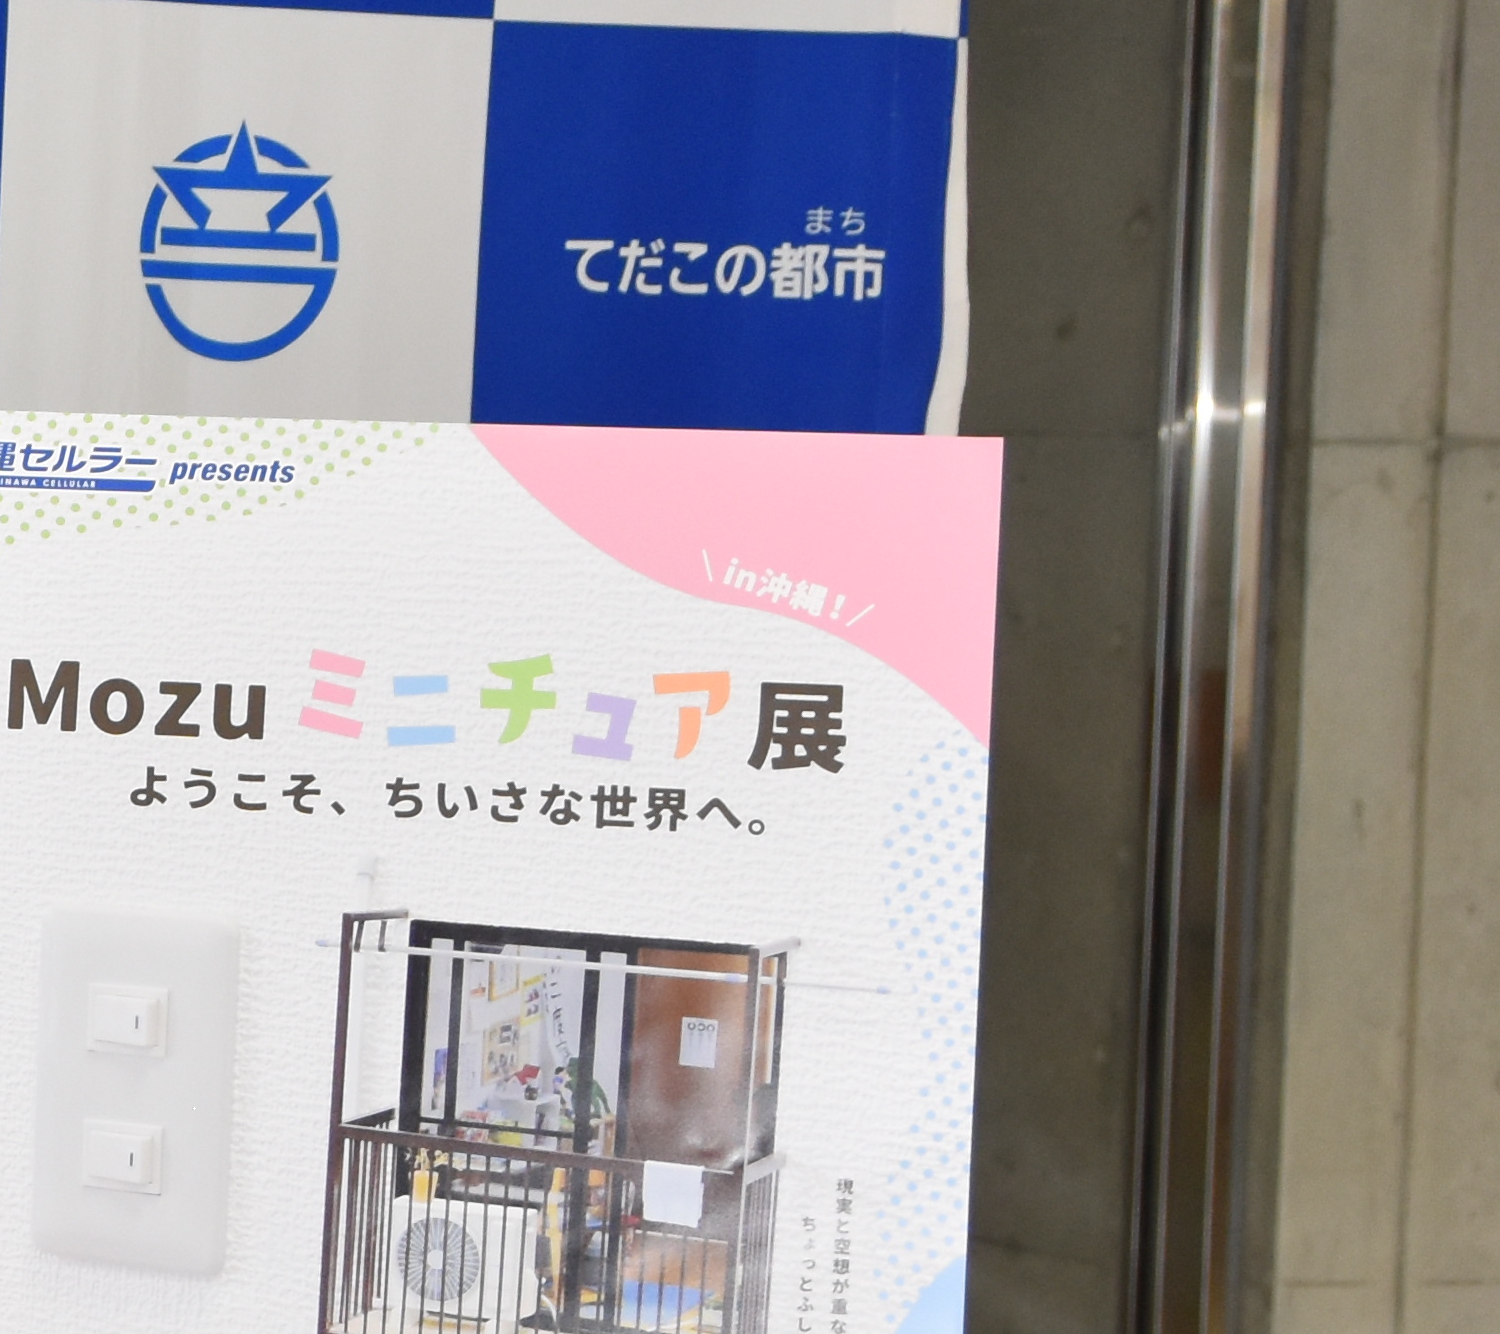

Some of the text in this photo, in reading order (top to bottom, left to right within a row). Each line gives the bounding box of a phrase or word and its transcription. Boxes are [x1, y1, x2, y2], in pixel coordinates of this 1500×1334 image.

[807, 208, 864, 234] まち
[566, 239, 885, 300] てだこの都市
[169, 459, 296, 485] presents
[6, 649, 848, 775] Mozu ミニチュア展
[129, 765, 770, 837] ようこそ、ちいさな世界へ。
